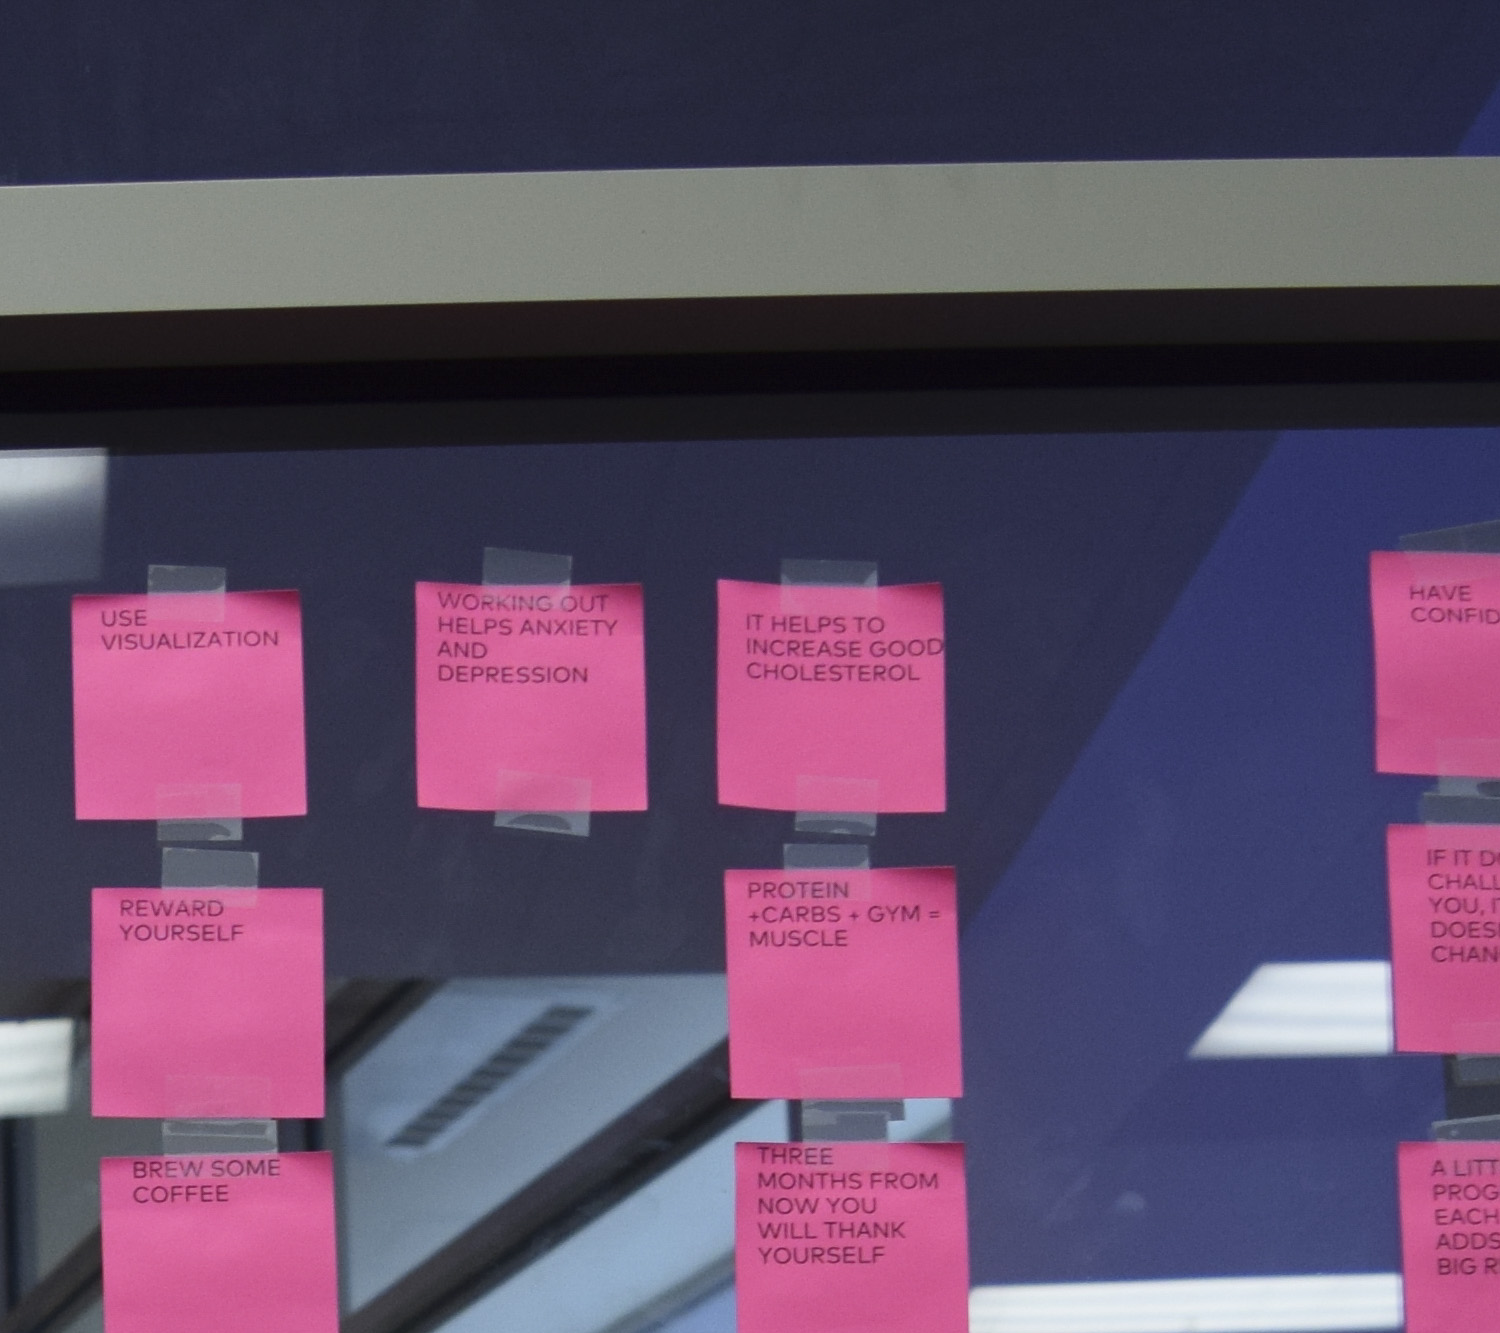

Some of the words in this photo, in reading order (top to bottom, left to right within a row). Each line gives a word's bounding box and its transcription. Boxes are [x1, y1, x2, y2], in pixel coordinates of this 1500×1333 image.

[437, 591, 553, 613] WORKING
[560, 594, 608, 613] OUT
[100, 608, 148, 628] USE
[437, 616, 513, 637] HELPS
[519, 618, 618, 637] ANXIETY
[100, 629, 280, 651] VISUALIZATION
[436, 640, 489, 660] AND
[437, 663, 589, 685] DEPRESSION
[1430, 1159, 1447, 1177] A
[1434, 1207, 1500, 1227] EACH
[1437, 1257, 1478, 1276] BIG
